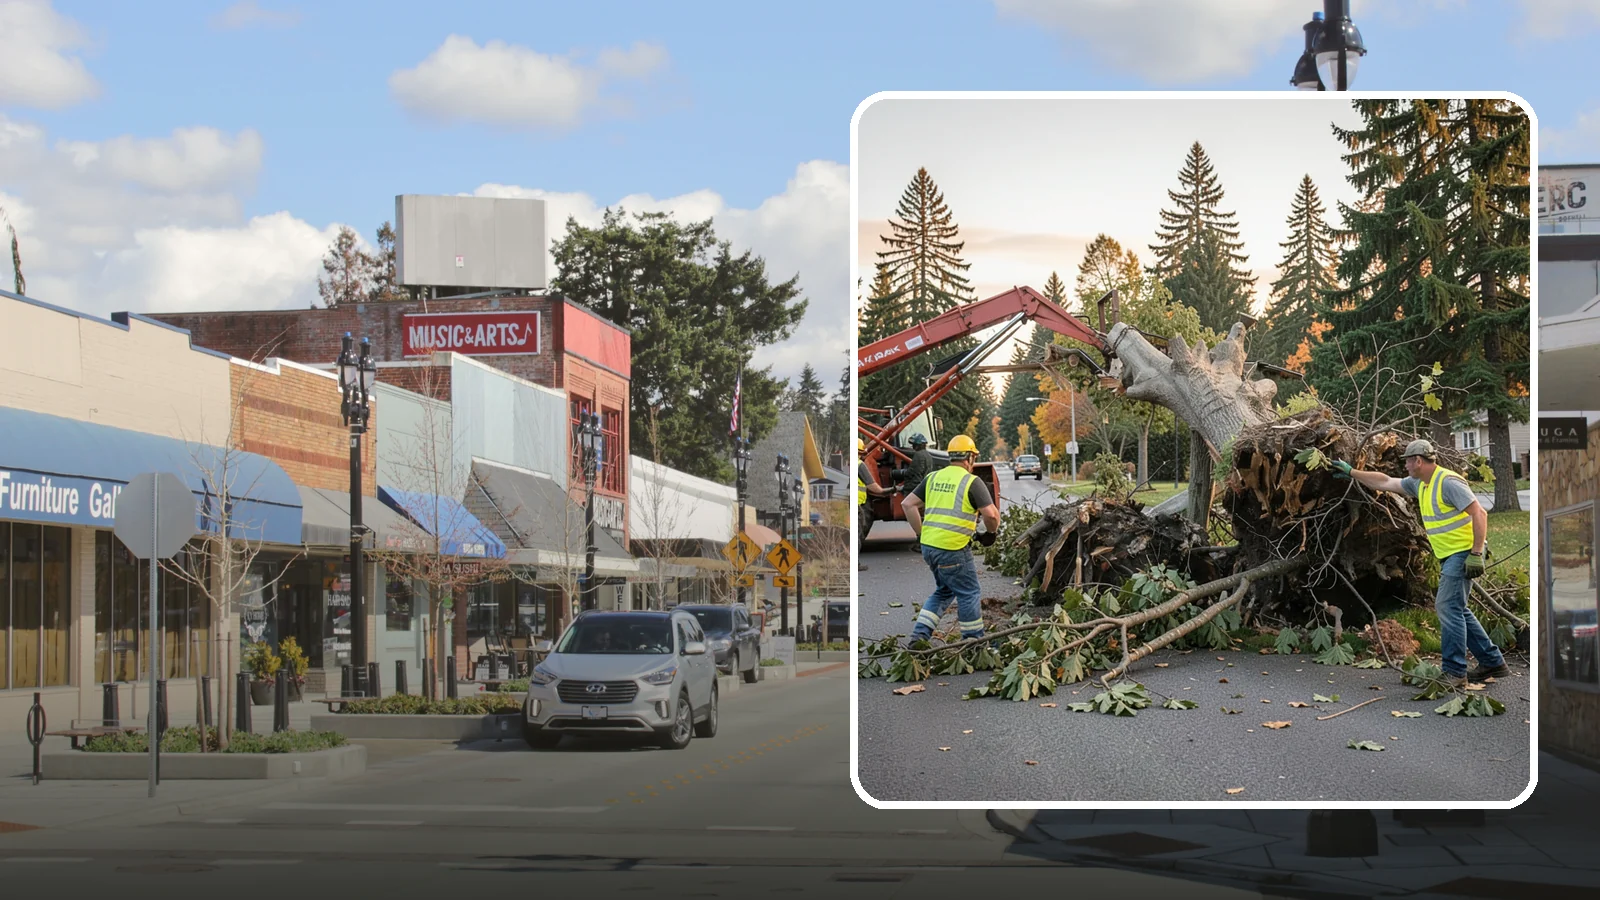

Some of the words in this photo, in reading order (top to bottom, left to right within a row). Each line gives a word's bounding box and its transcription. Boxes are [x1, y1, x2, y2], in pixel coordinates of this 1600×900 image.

[409, 323, 519, 348] MUSIC&ARTS
[0, 471, 79, 515] Furniture
[89, 482, 122, 519] Gal
